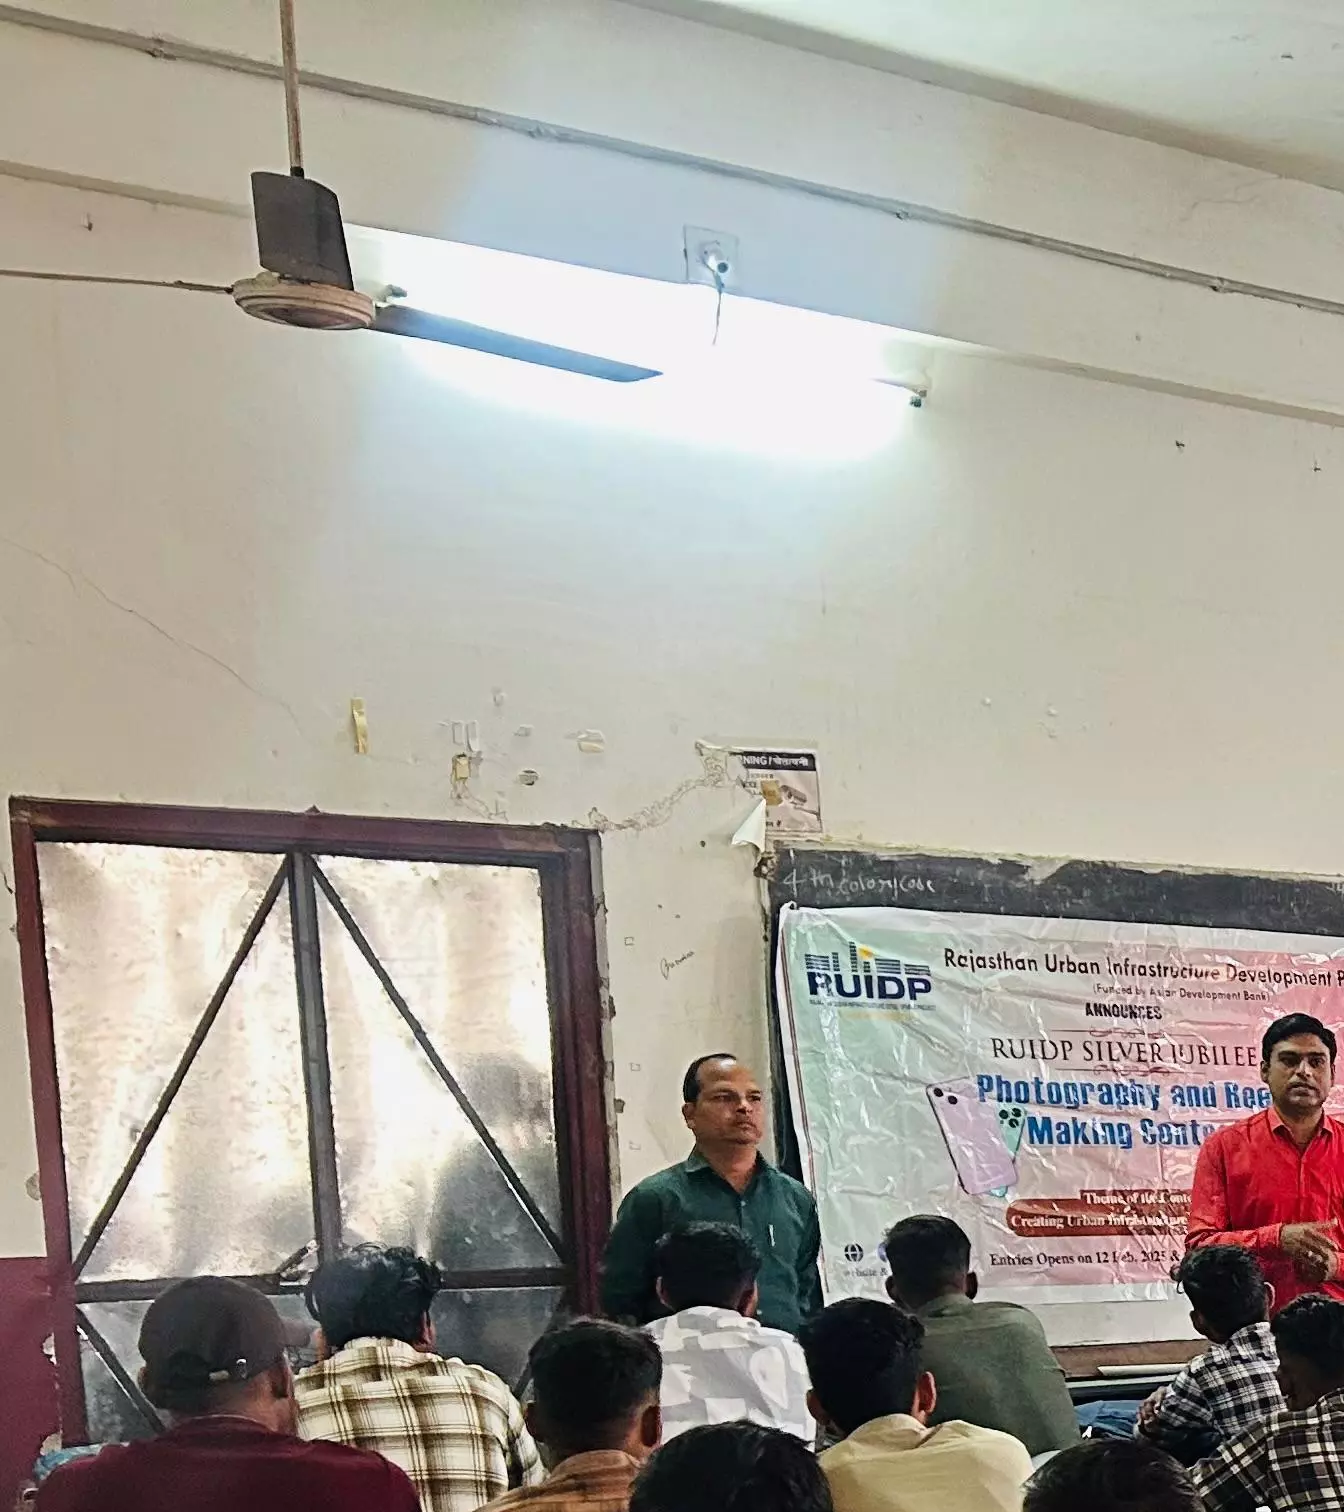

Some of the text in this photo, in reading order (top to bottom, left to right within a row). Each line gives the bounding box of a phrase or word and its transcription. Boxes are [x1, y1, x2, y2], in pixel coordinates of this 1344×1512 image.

[945, 948, 1038, 973] Rajasthan
[1045, 953, 1100, 974] Urban
[1107, 956, 1220, 980] Infrastructure
[1227, 964, 1331, 987] Development
[807, 971, 932, 1000] RUIDP
[1135, 986, 1146, 998] by
[1179, 988, 1241, 1000] Development
[1244, 990, 1270, 1001] Bank)
[1085, 1002, 1163, 1020] ANNOUNCES
[990, 1037, 1257, 1067] RUIDP SILVER JUBILEE
[976, 1074, 1272, 1111] Photography and Ree
[1027, 1116, 1133, 1149] Making
[1083, 1192, 1124, 1205] Theme
[1011, 1215, 1064, 1229] Creating
[1067, 1215, 1104, 1227] Urban
[990, 1253, 1033, 1266] Entries
[1036, 1252, 1074, 1267] Opens
[1077, 1254, 1092, 1264] on
[1096, 1252, 1110, 1264] 12
